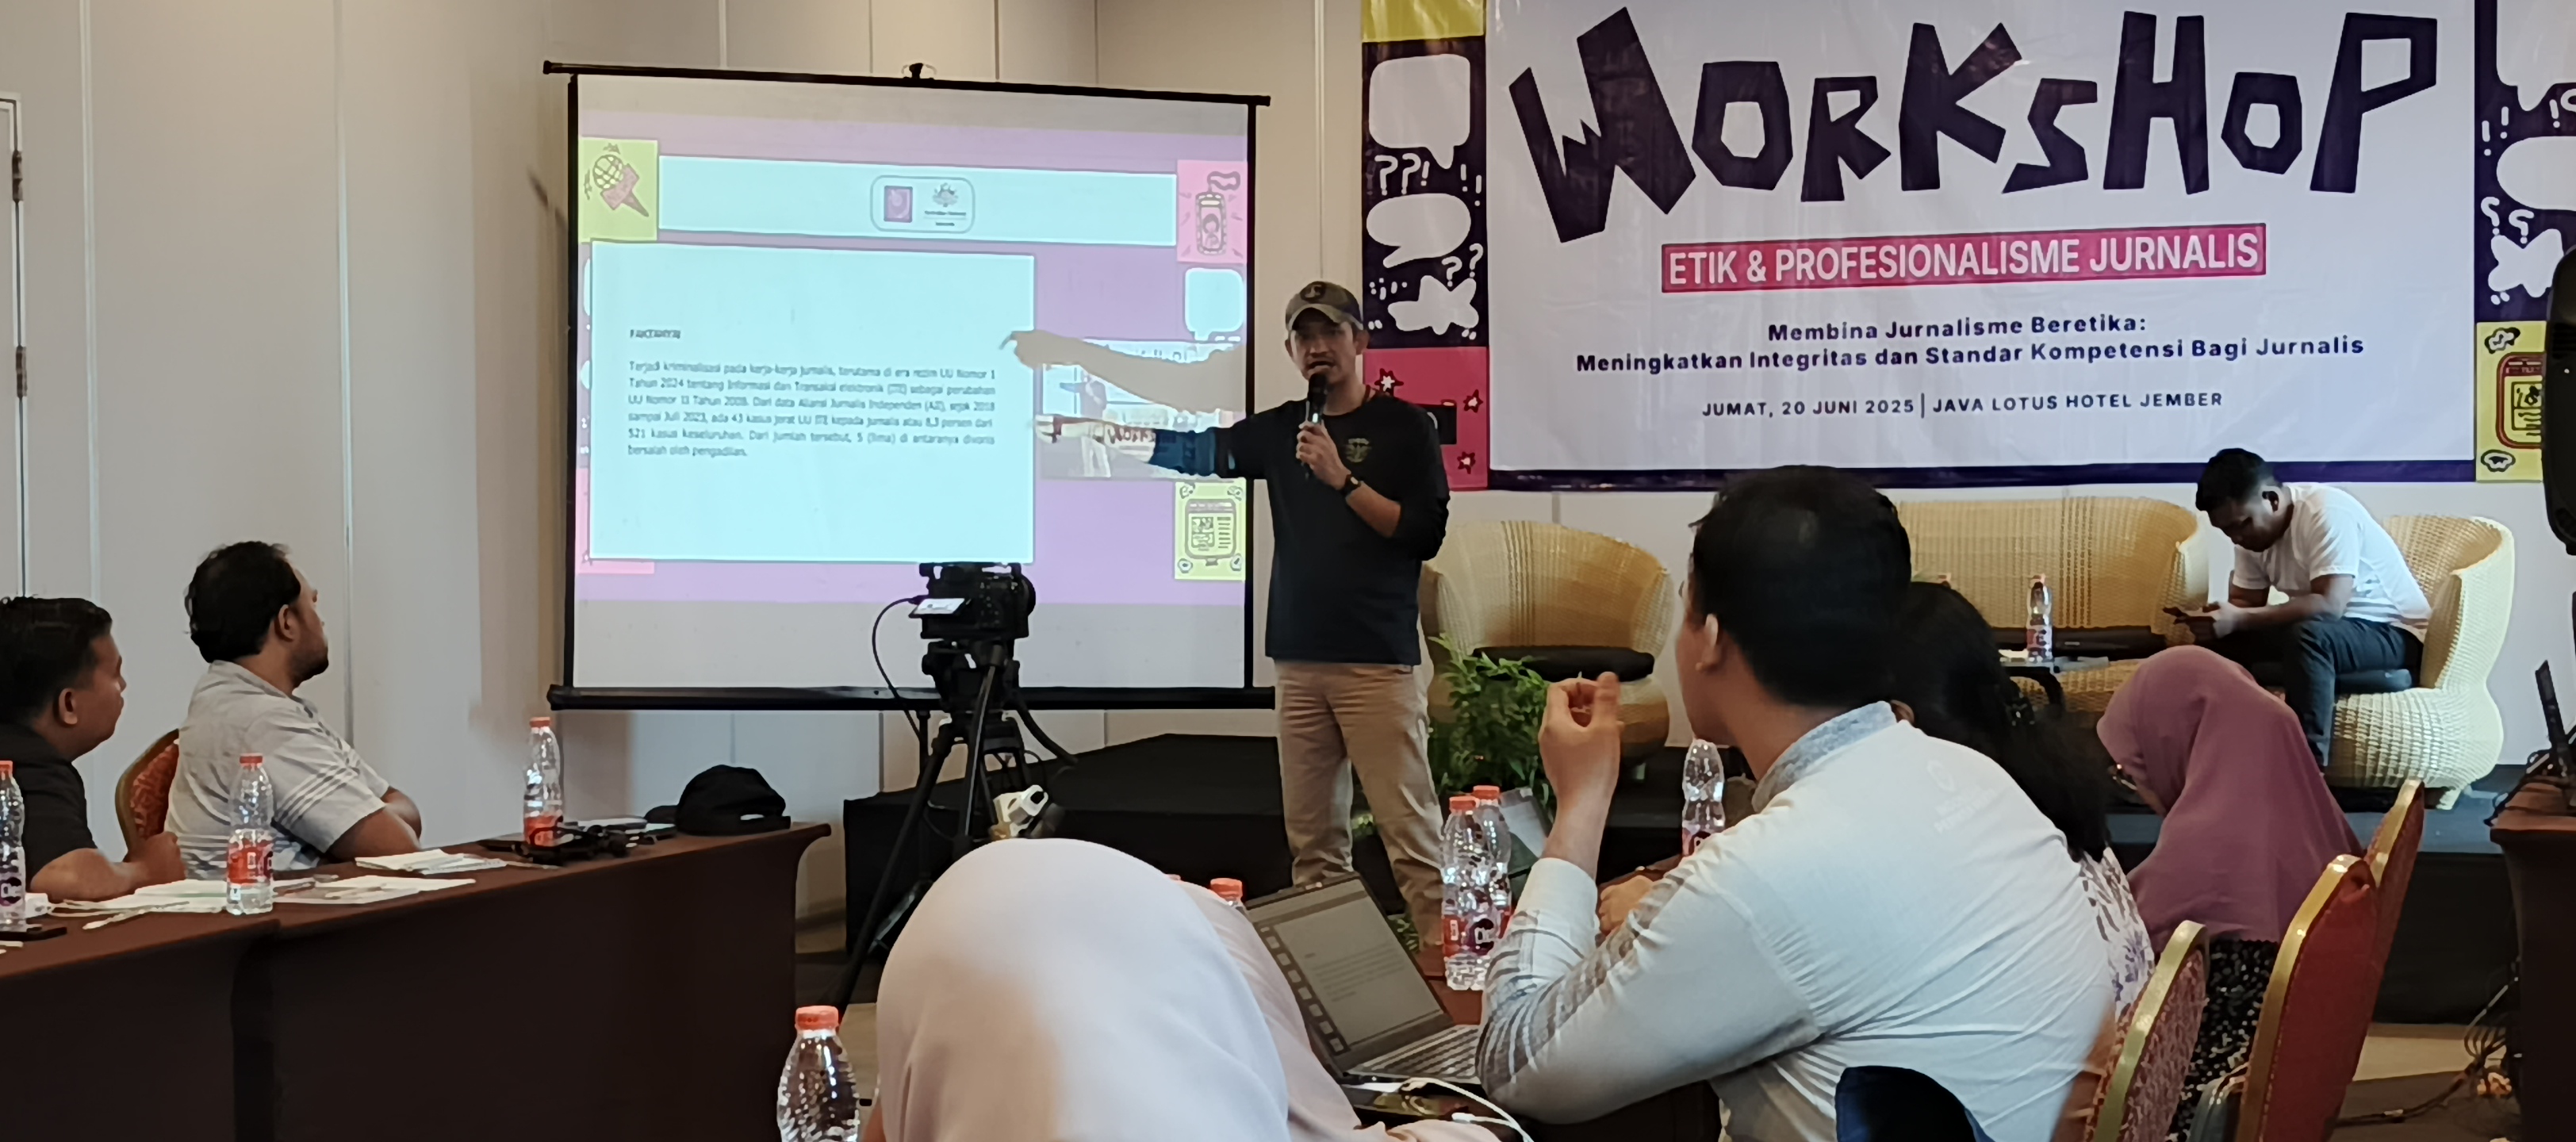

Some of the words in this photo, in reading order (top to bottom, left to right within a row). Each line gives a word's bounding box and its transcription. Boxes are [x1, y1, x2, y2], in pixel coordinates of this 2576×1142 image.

[1669, 251, 1737, 285] ETIK
[1746, 251, 1767, 283] &
[1776, 239, 2080, 282] PROFESIONALISME
[2089, 232, 2259, 272] JURNALIS
[1768, 321, 1877, 341] Membina
[1884, 316, 2023, 339] Jurnalisme
[2031, 314, 2145, 334] Beretika:
[1577, 352, 1742, 374] Meningkatkan
[1750, 347, 1866, 371] Integritas
[1875, 347, 1918, 366] dan
[1925, 345, 2023, 364] Standar
[2031, 339, 2183, 363] Kompetensi
[2191, 338, 2247, 361] Bagi
[2256, 334, 2364, 356] Jurnalis
[1702, 401, 1774, 418] JUMAT,
[1782, 400, 1806, 416] 20
[1813, 400, 1857, 415] JUNI
[1865, 399, 1914, 413] 2025
[1933, 397, 1984, 412] JAVA
[1991, 395, 2058, 412] LOTUS
[2066, 393, 2132, 408] HOTEL
[2140, 392, 2222, 408] JEMBER
